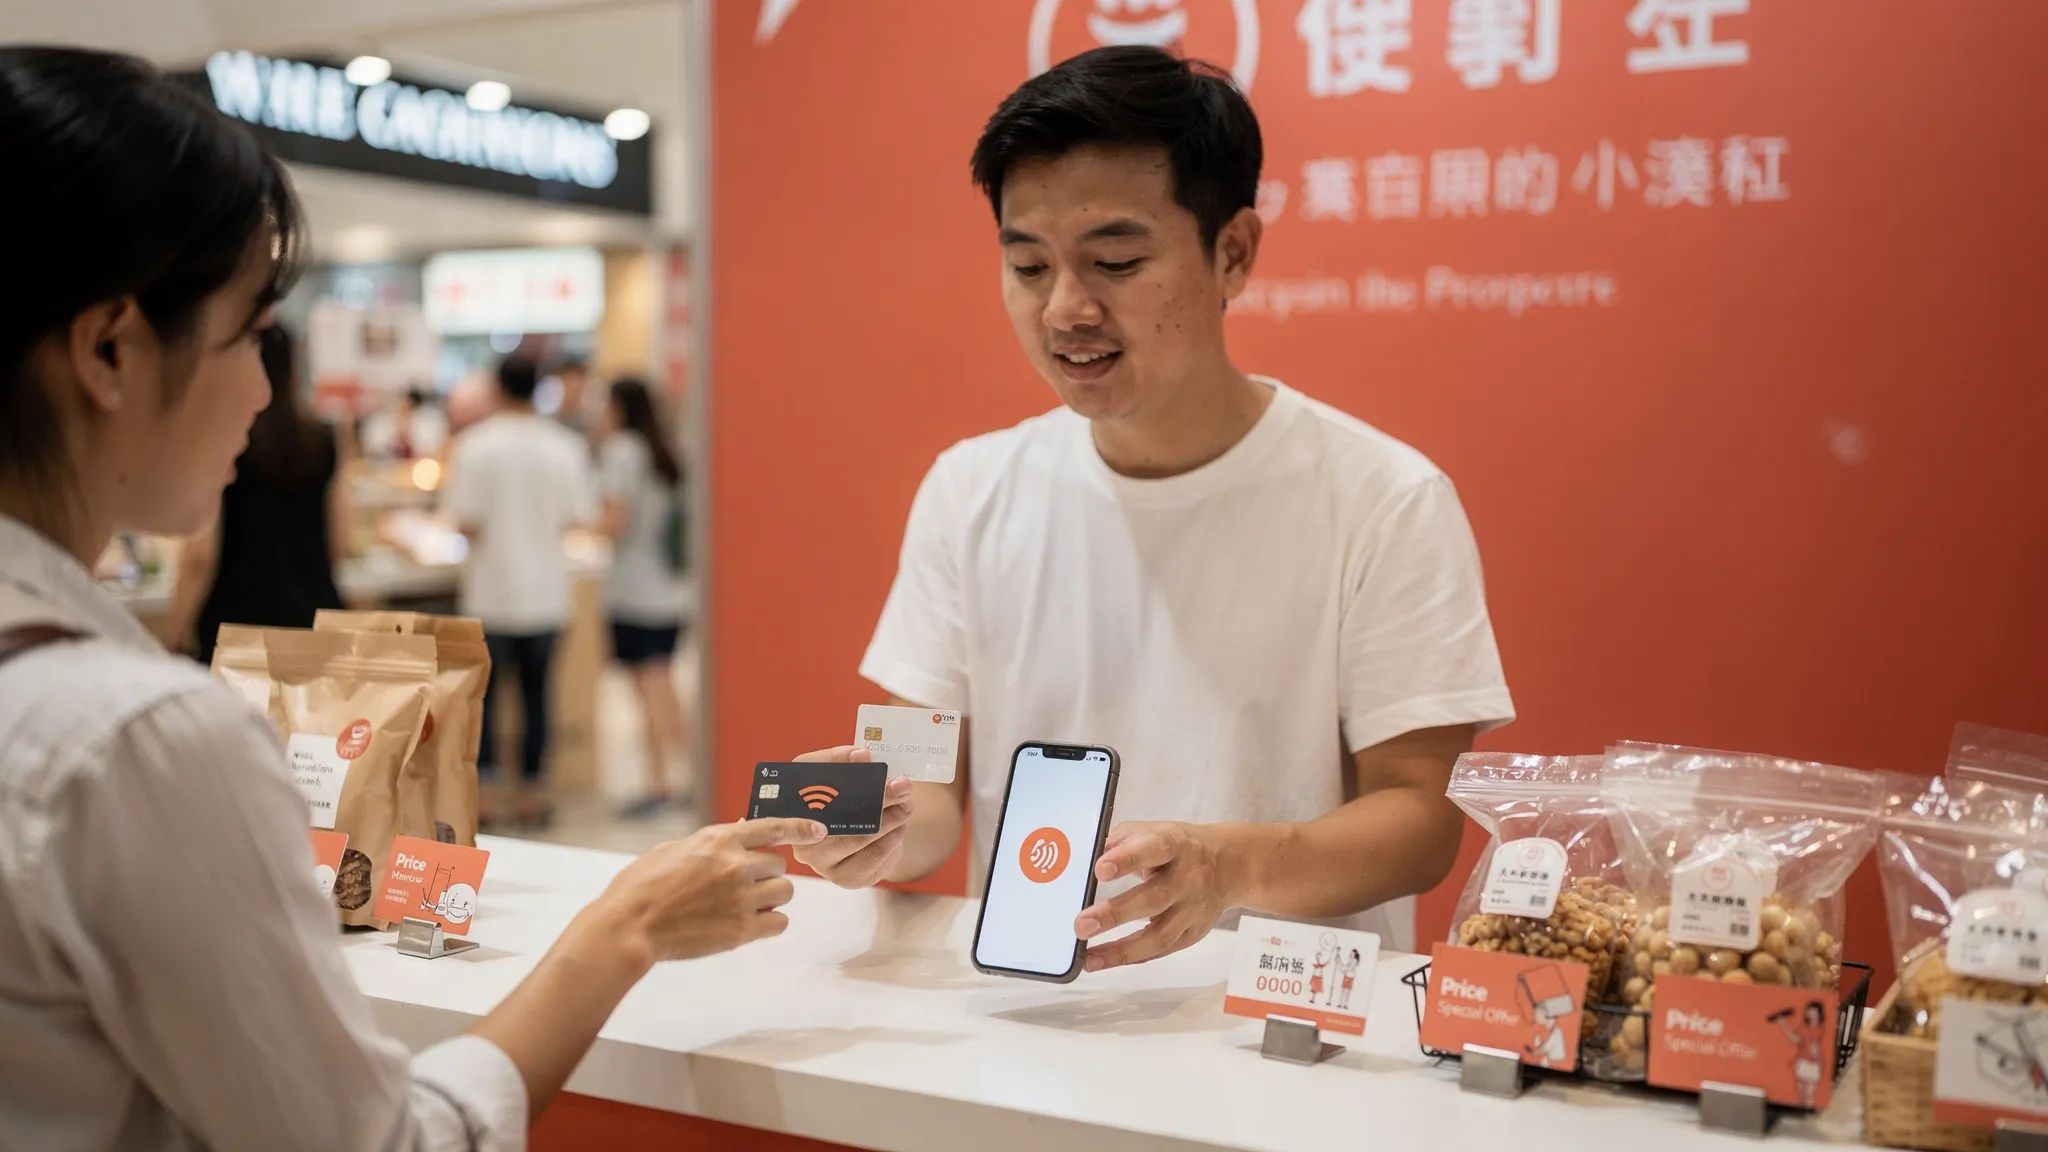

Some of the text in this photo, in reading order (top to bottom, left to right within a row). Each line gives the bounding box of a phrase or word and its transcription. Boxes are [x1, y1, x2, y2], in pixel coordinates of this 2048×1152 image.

[395, 853, 427, 871] Price
[1441, 975, 1489, 1002] Price
[1437, 999, 1520, 1027] Special Offer
[1665, 1007, 1724, 1037] Price
[1663, 1033, 1758, 1061] Special Offer
